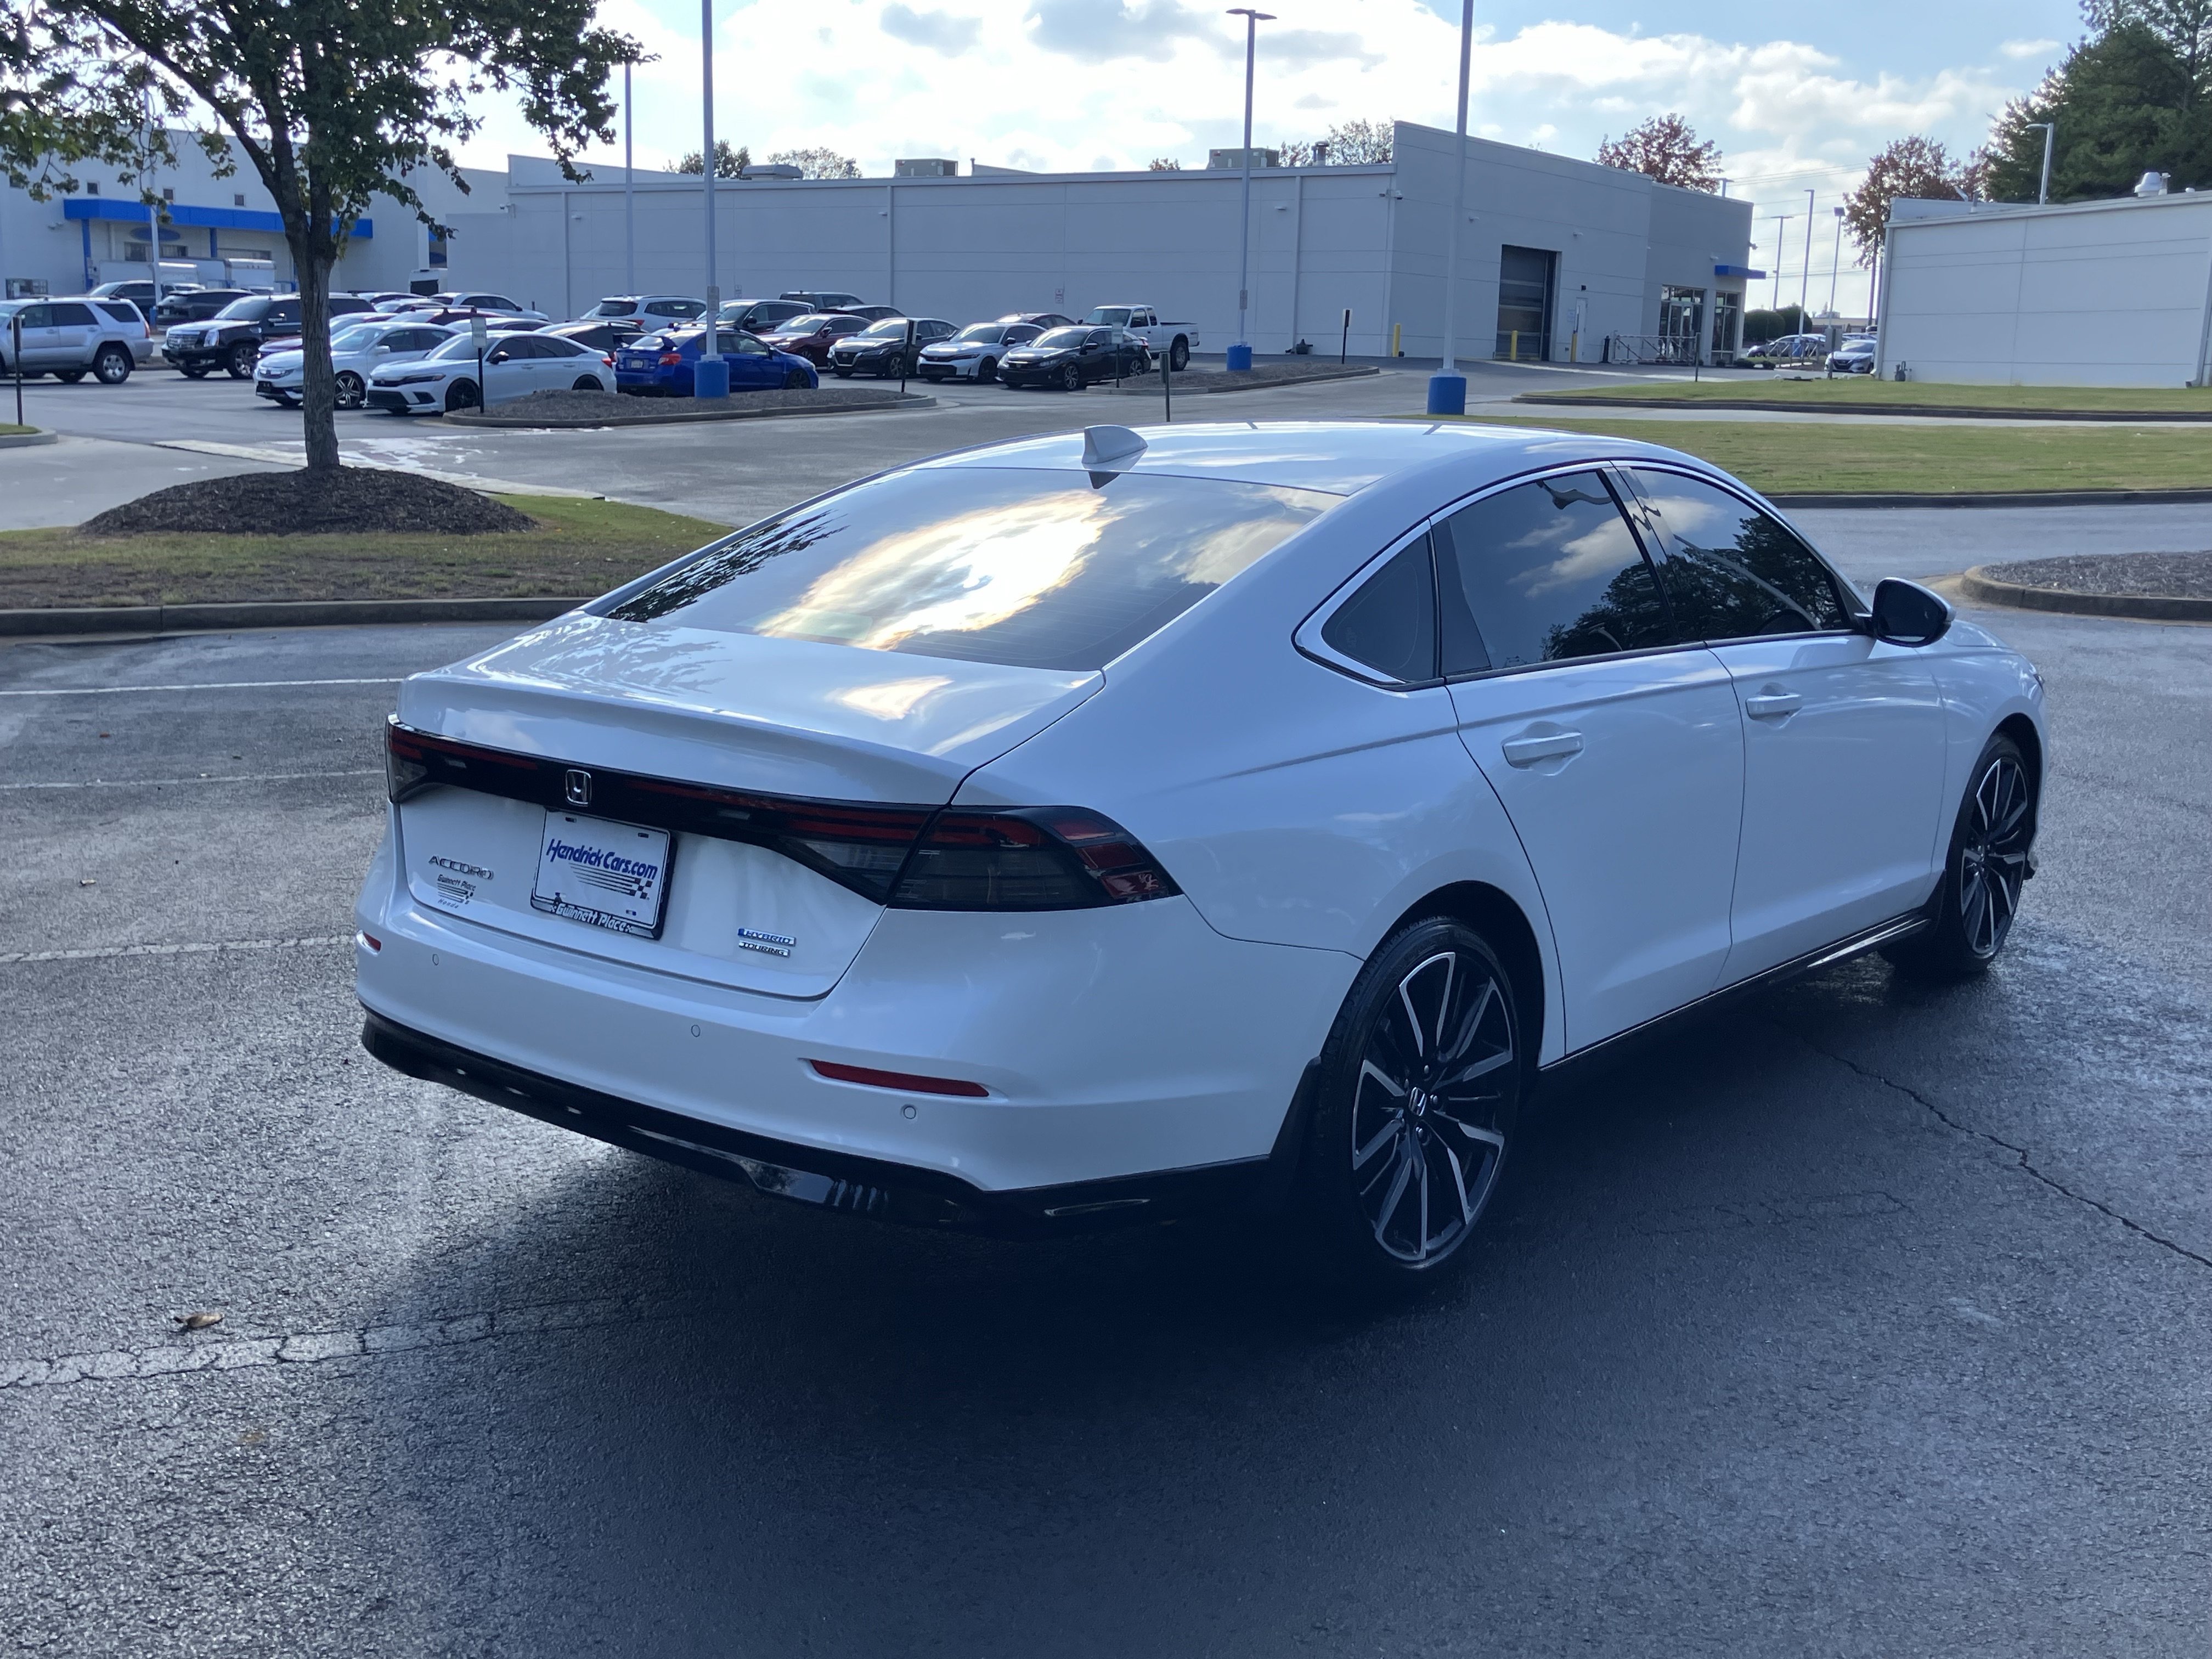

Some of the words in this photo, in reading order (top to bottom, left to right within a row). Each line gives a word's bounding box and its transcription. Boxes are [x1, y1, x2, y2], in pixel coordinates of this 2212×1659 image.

[428, 855, 494, 880] ACCORD
[438, 898, 459, 909] Honda
[556, 903, 597, 924] Gwinnett
[598, 912, 627, 932] Place
[746, 930, 791, 944] HYBRID
[743, 941, 785, 955] TOURING
